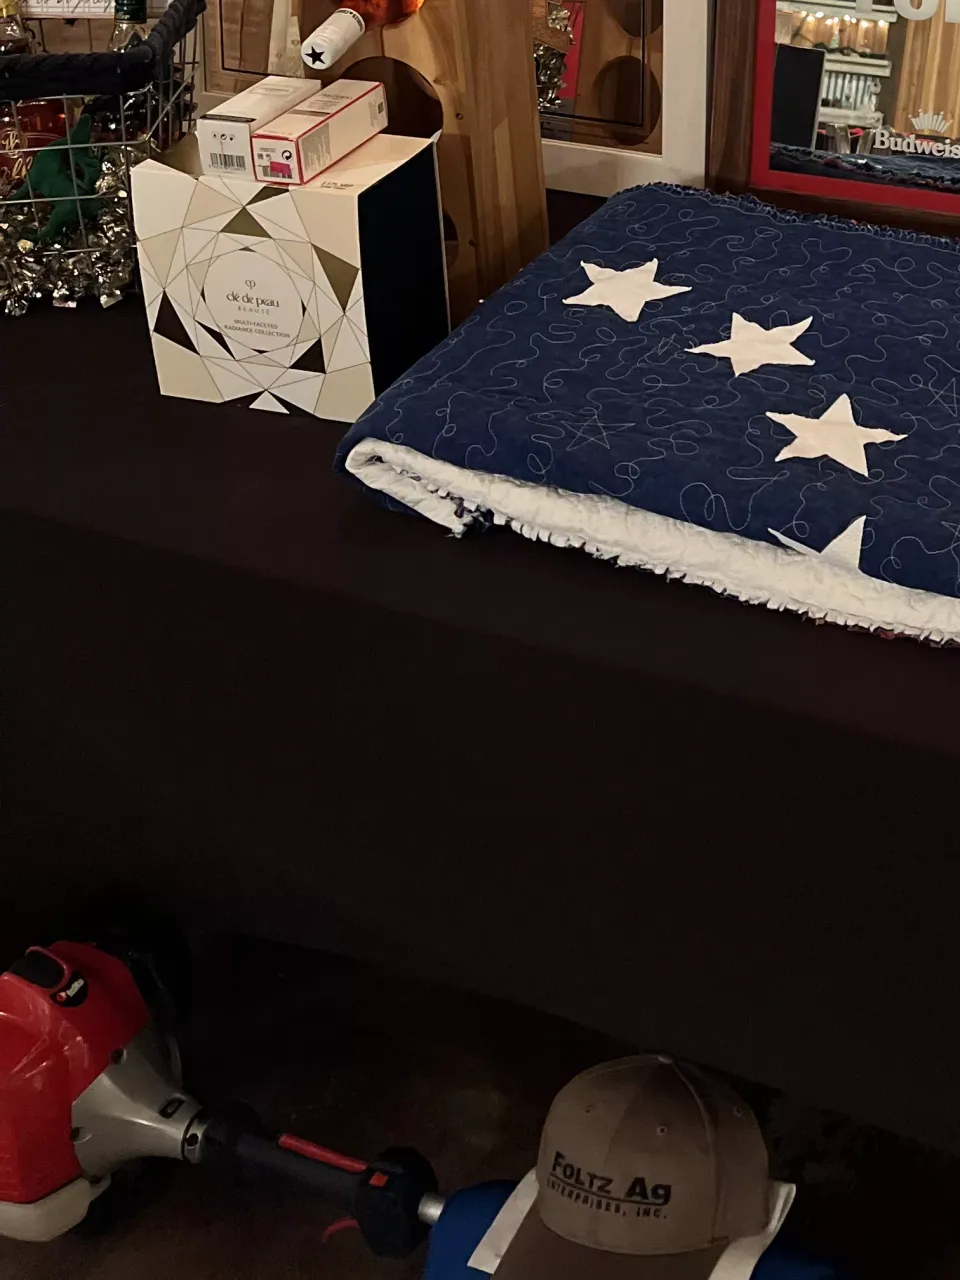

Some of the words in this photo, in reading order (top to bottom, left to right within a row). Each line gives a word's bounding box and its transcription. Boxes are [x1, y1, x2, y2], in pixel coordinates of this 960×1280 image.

[255, 297, 280, 308] peau
[624, 1176, 673, 1207] Ag
[636, 1207, 668, 1219] INC.
